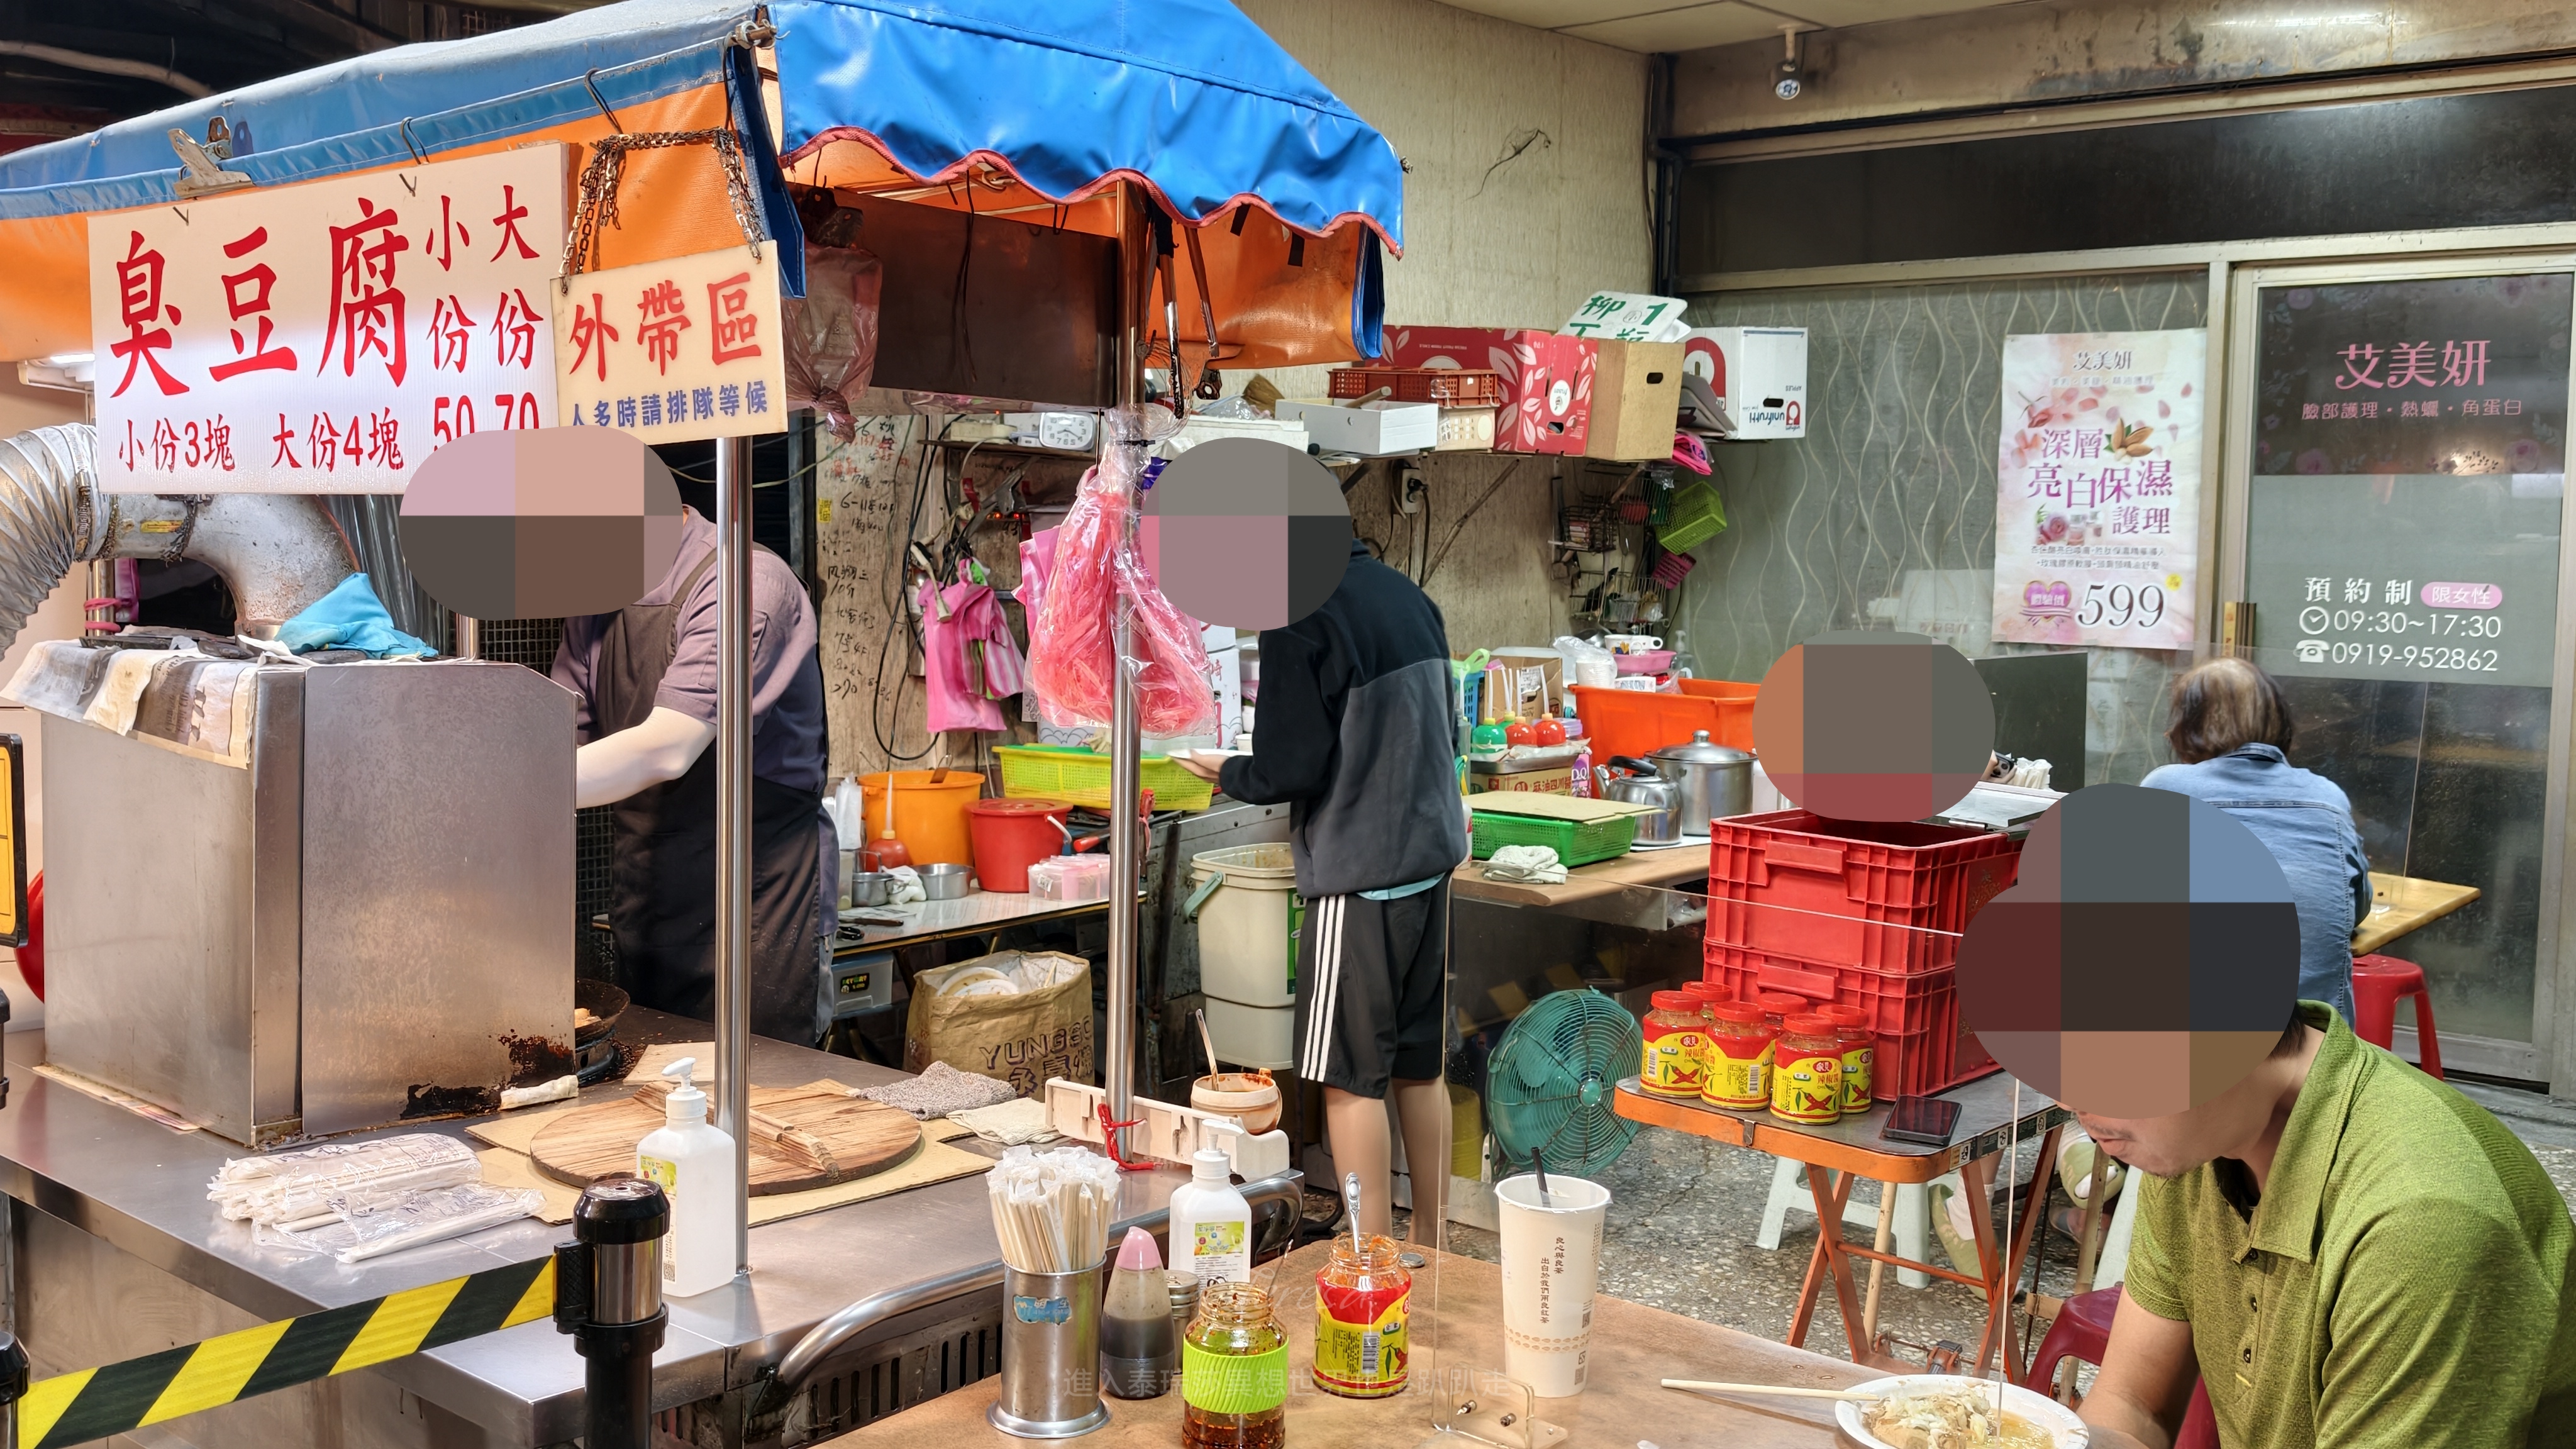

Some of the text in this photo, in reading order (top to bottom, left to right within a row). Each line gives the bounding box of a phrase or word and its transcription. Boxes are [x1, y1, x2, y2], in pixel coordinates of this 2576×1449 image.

[110, 197, 409, 398] 臭豆腐
[568, 272, 762, 382] 外帶區
[2334, 340, 2492, 391] 艾美妍
[572, 380, 768, 428] 人多時請排隊等候
[119, 413, 236, 473] 小份3塊
[271, 406, 404, 473] 大份4塊
[2041, 428, 2104, 460] 深層
[2026, 459, 2173, 508] 亮白保濕
[2112, 506, 2171, 535] 護理
[2078, 584, 2164, 628] 599
[2304, 577, 2491, 605] 預約制 限女性
[2333, 609, 2502, 638] 09:30~17:30
[2332, 641, 2499, 672] 0919-952862
